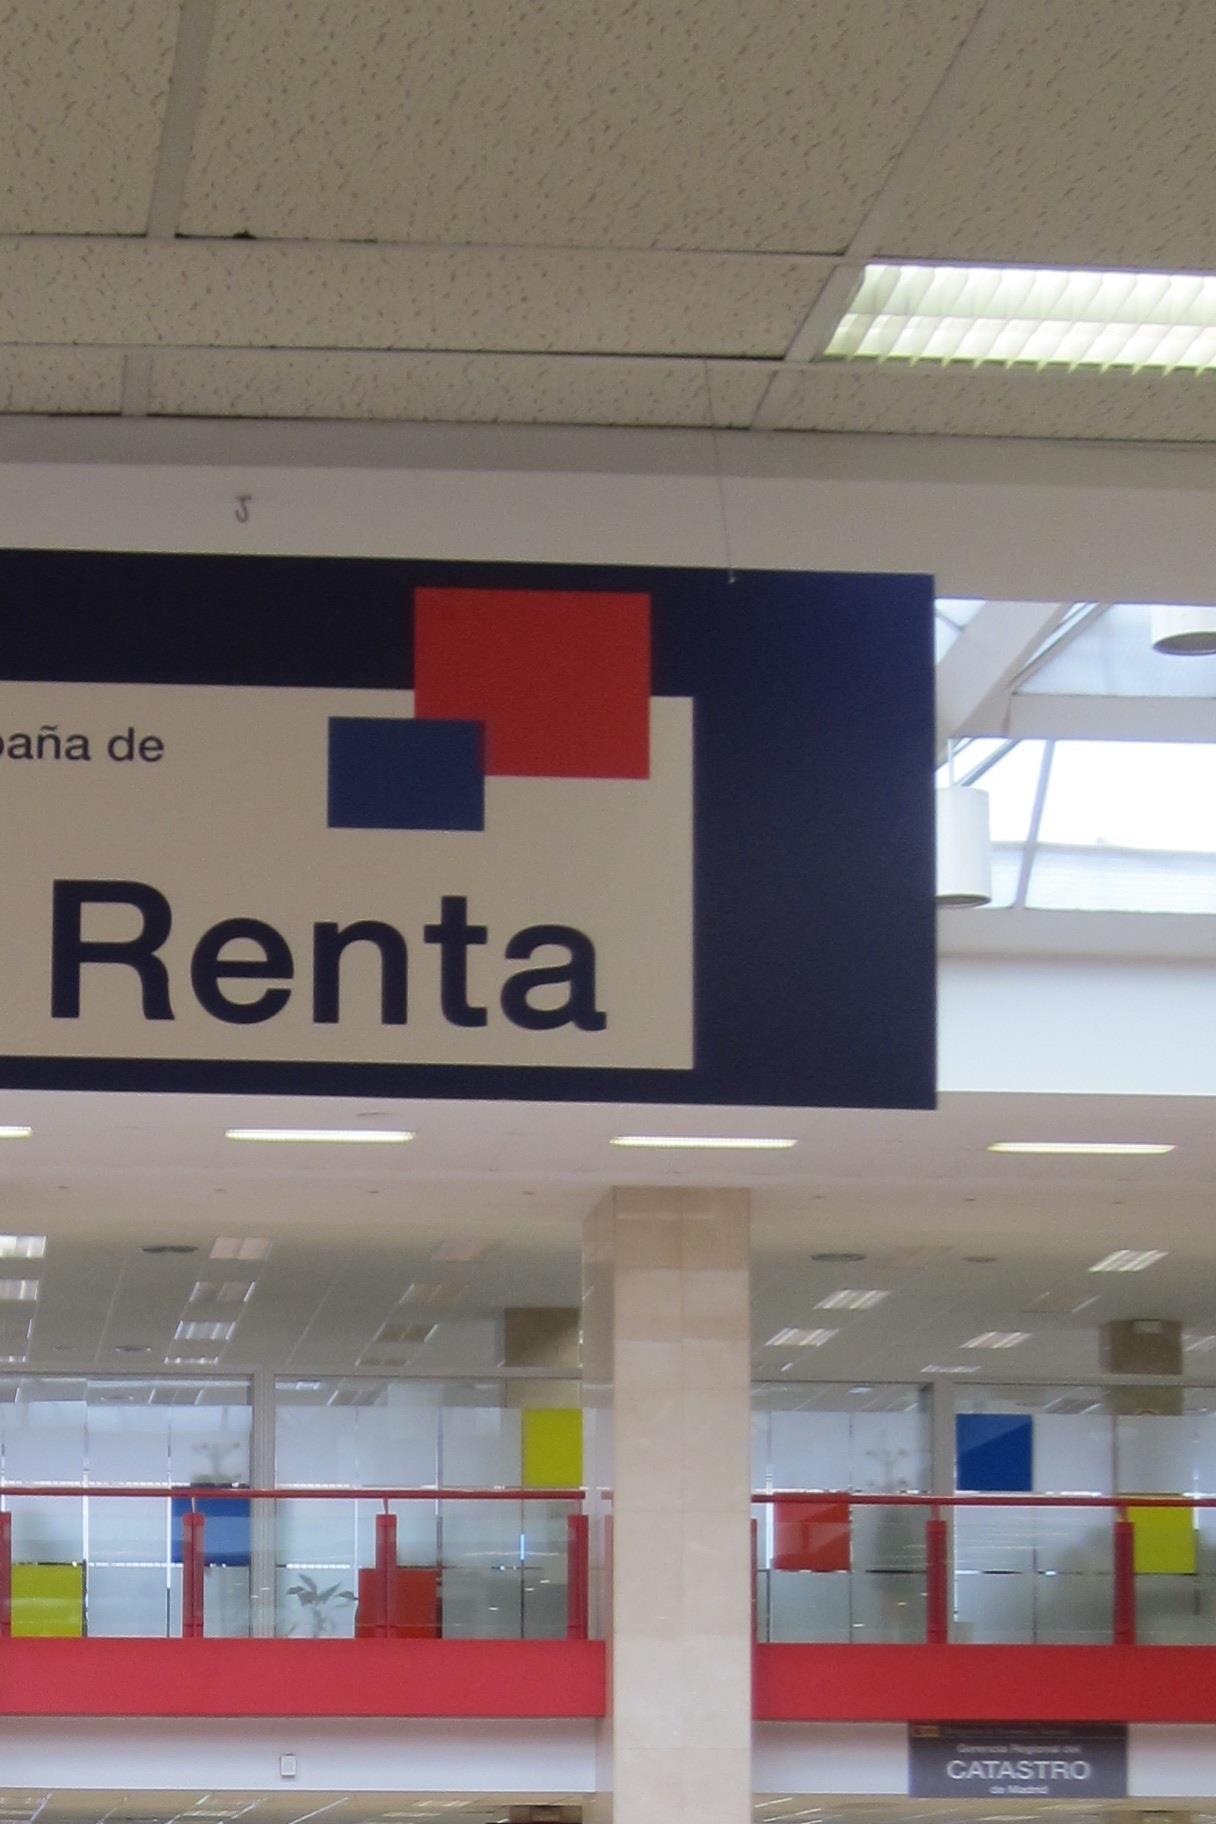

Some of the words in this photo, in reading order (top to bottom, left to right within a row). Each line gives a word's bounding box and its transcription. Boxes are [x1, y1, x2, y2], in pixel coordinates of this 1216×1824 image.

[106, 727, 165, 762] de
[50, 878, 608, 1032] Renta
[946, 1760, 1091, 1780] CATASTRO
